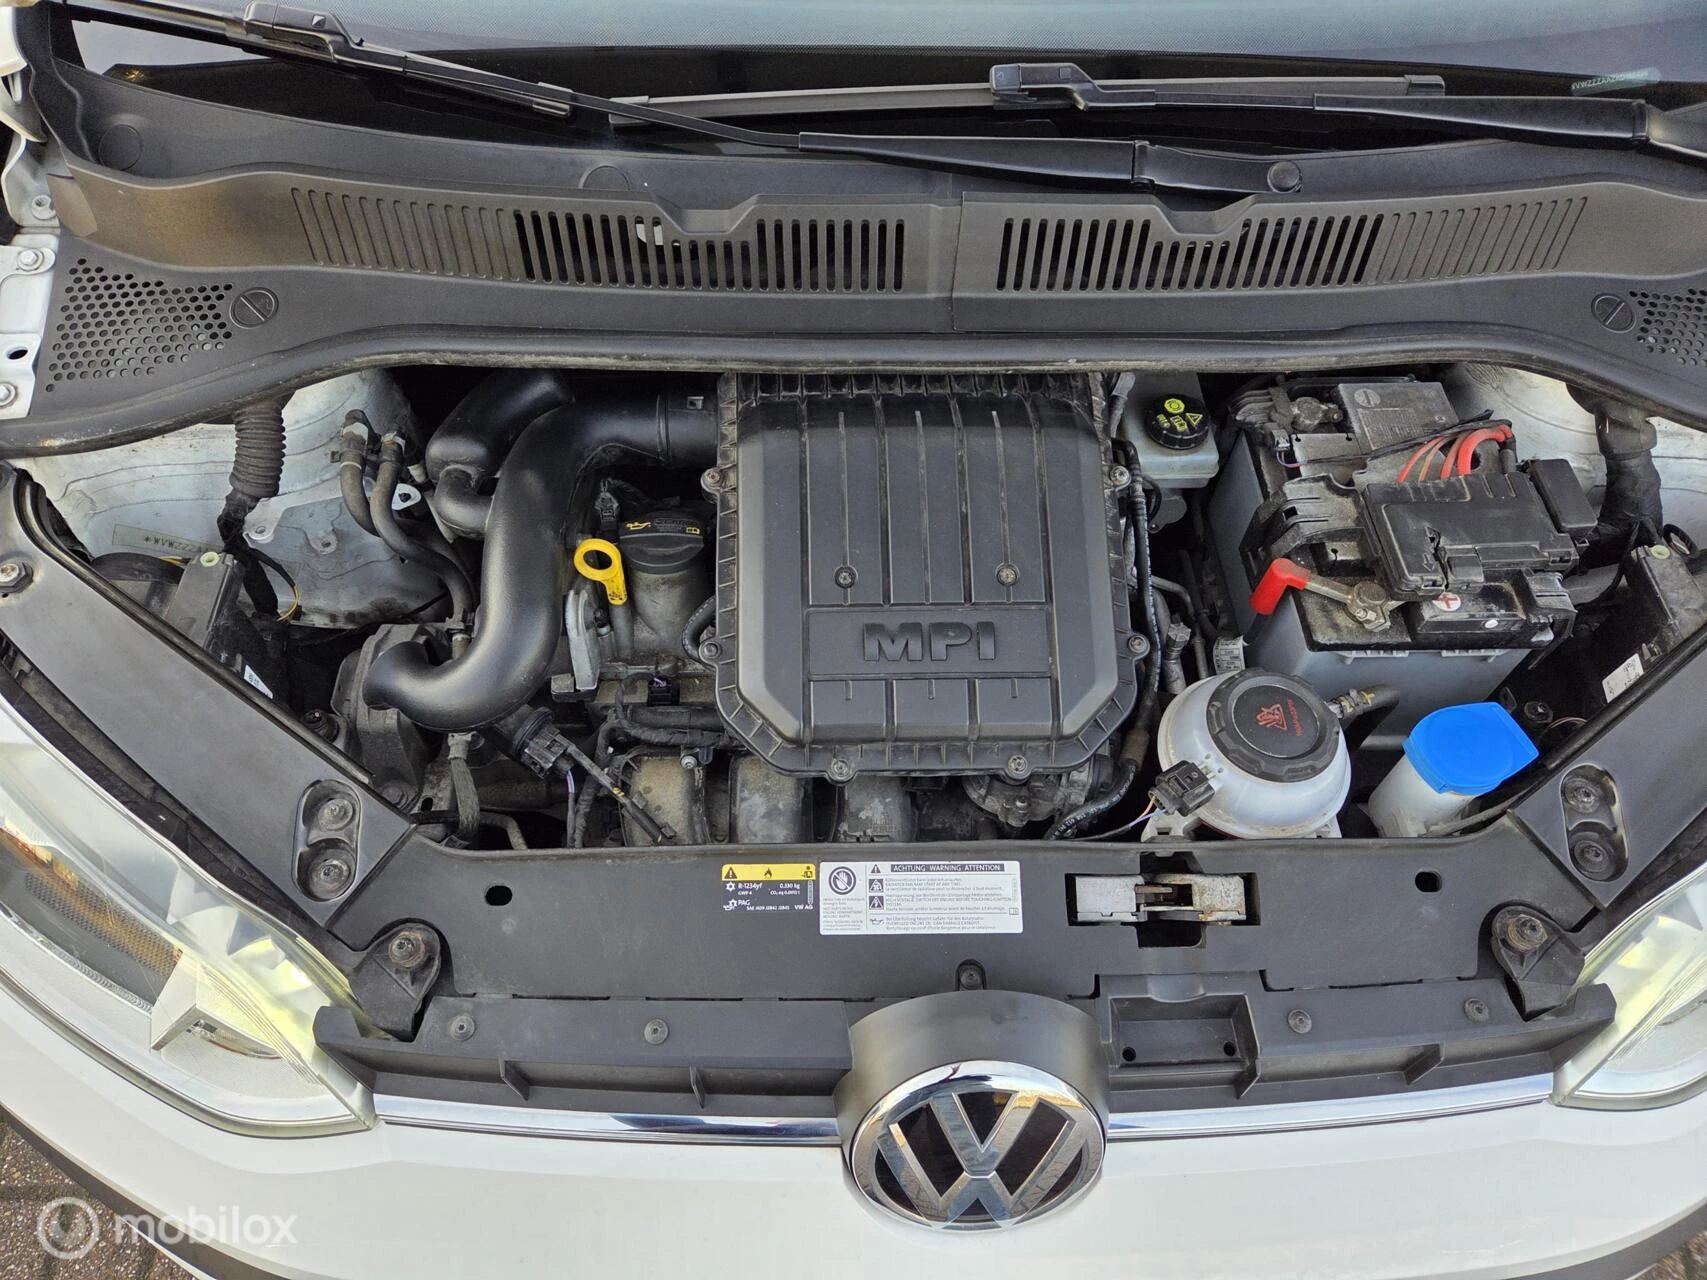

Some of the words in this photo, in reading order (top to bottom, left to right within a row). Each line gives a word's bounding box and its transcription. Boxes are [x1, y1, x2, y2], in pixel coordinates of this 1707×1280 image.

[863, 621, 996, 662] MPI
[929, 864, 962, 872] WARNING
[964, 864, 1001, 872] ATTENTION
[738, 882, 763, 891] R-1234yf
[874, 1088, 1090, 1228] VW
